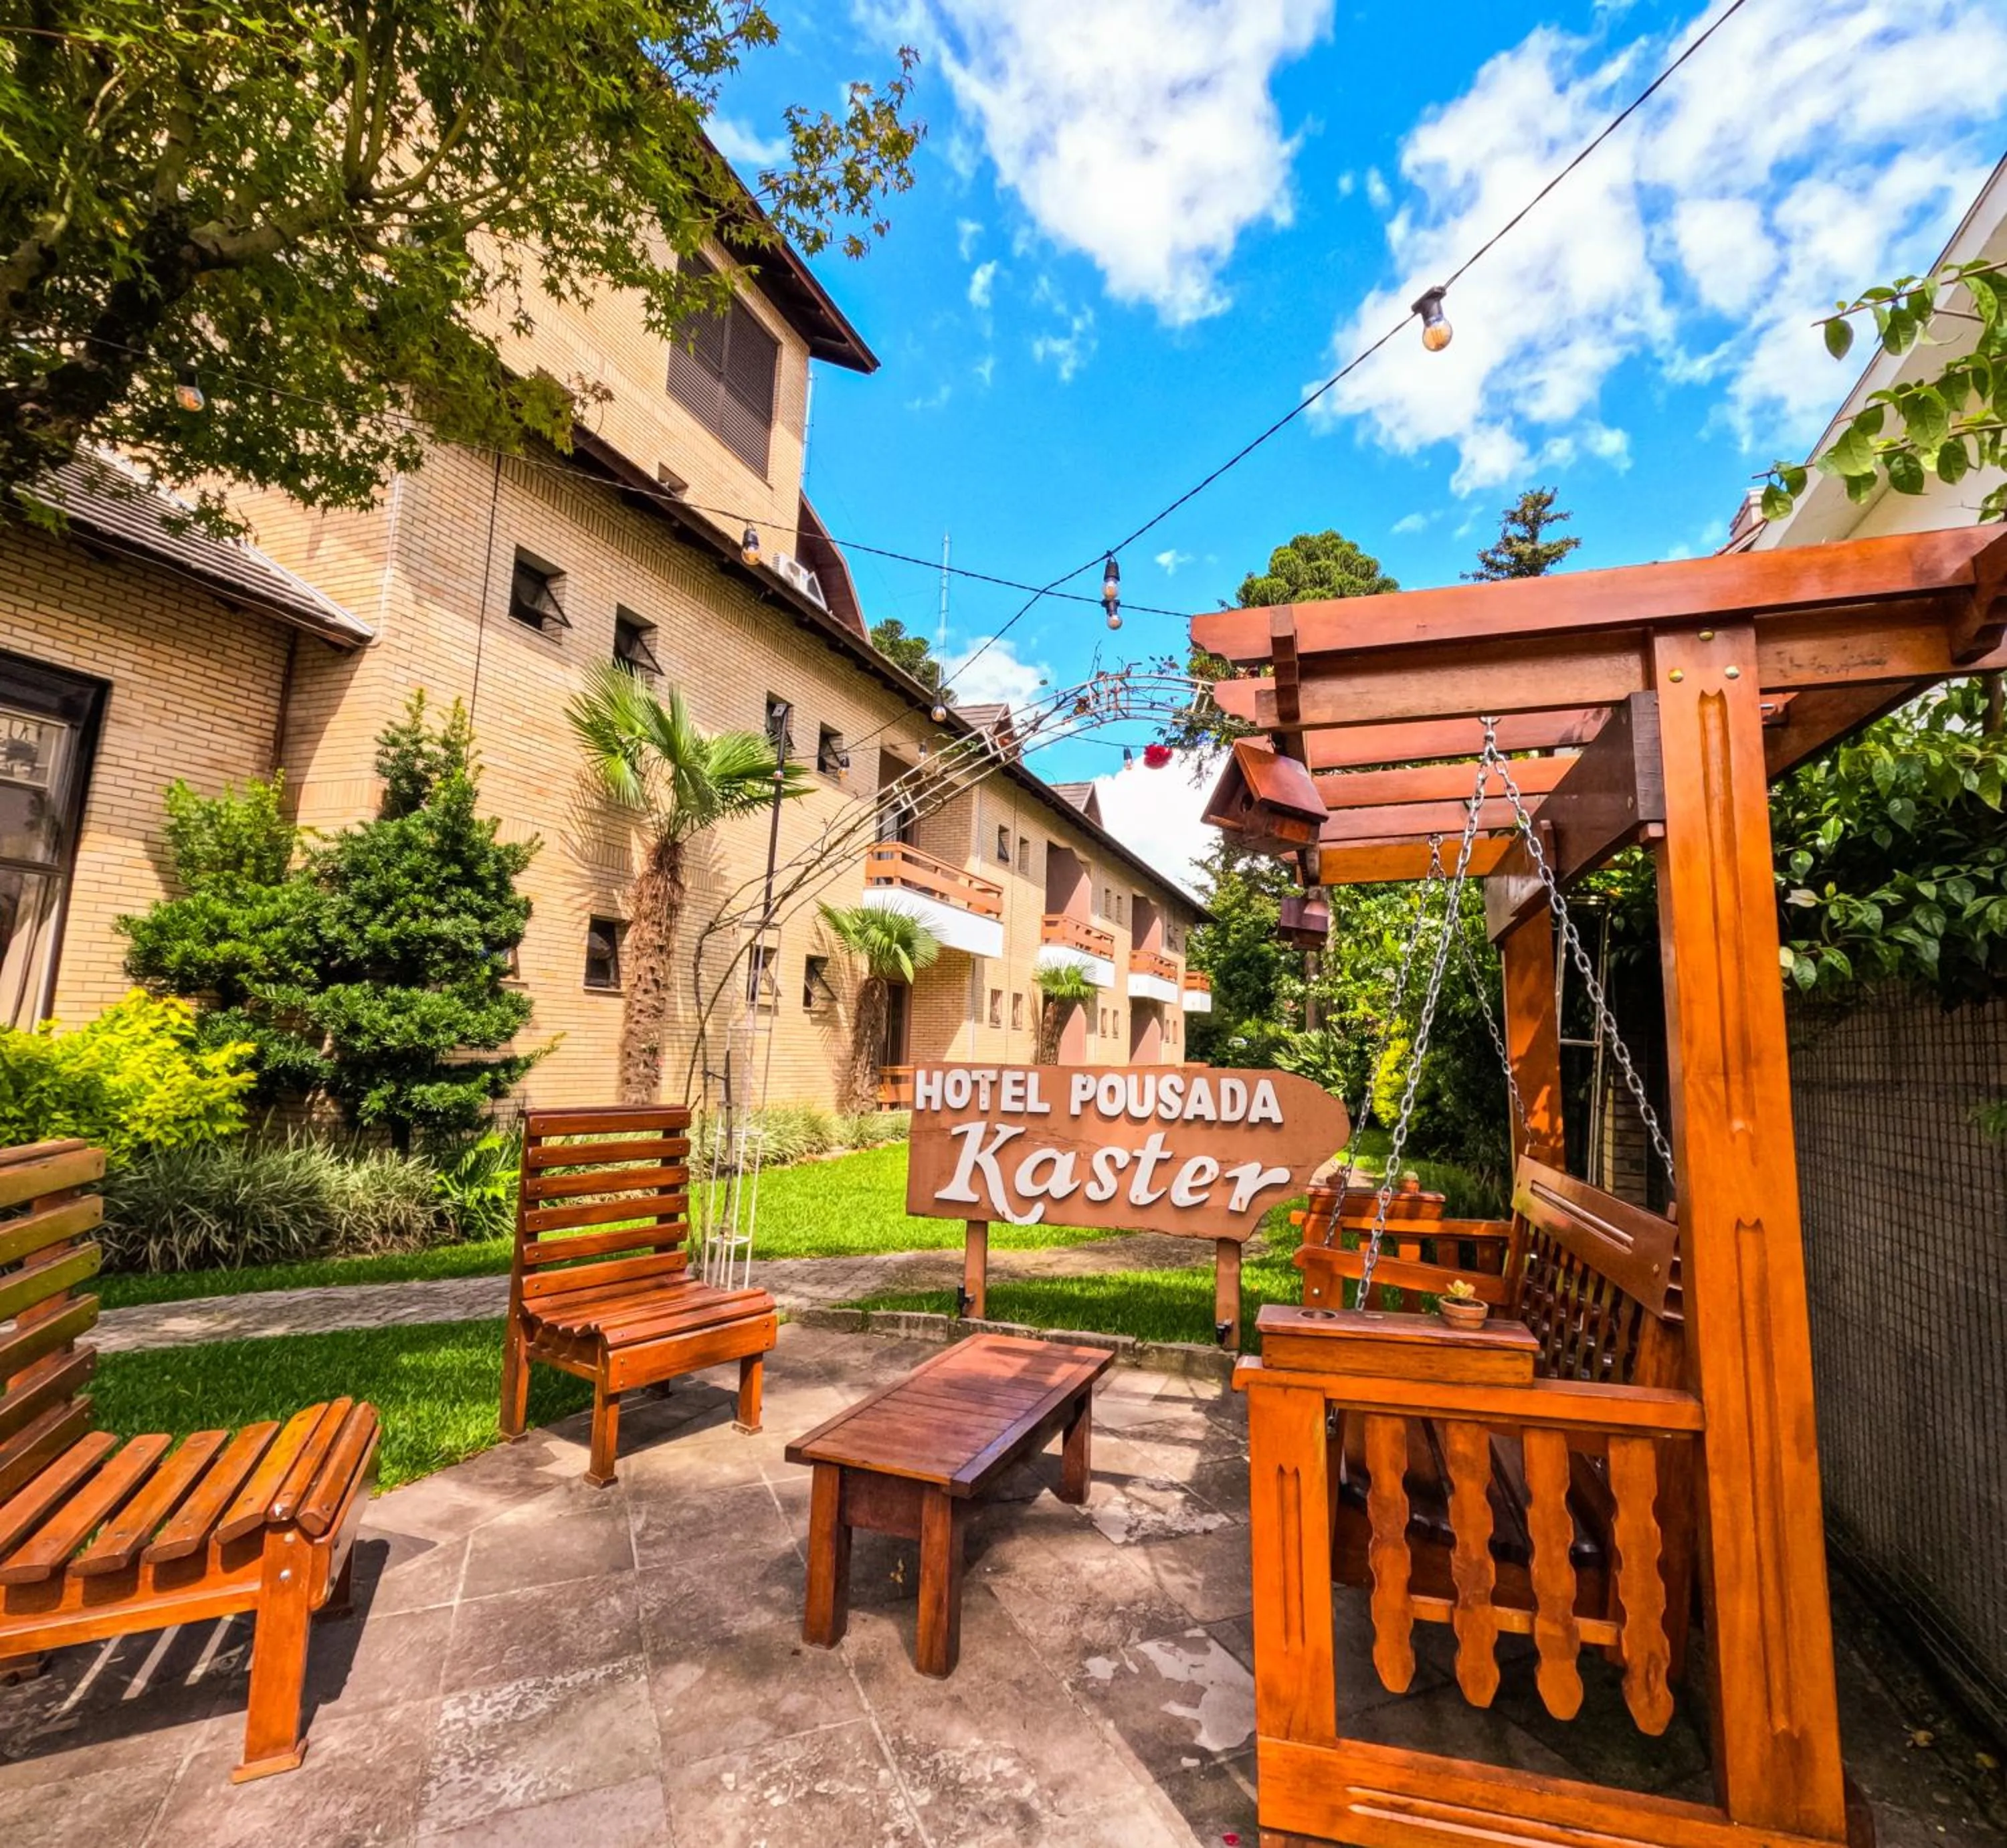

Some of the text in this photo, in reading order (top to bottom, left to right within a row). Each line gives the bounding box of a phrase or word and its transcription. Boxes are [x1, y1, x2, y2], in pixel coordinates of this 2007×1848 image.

[915, 1069, 1284, 1123] HOTEL POUSADA
[934, 1121, 1291, 1225] Kaster
